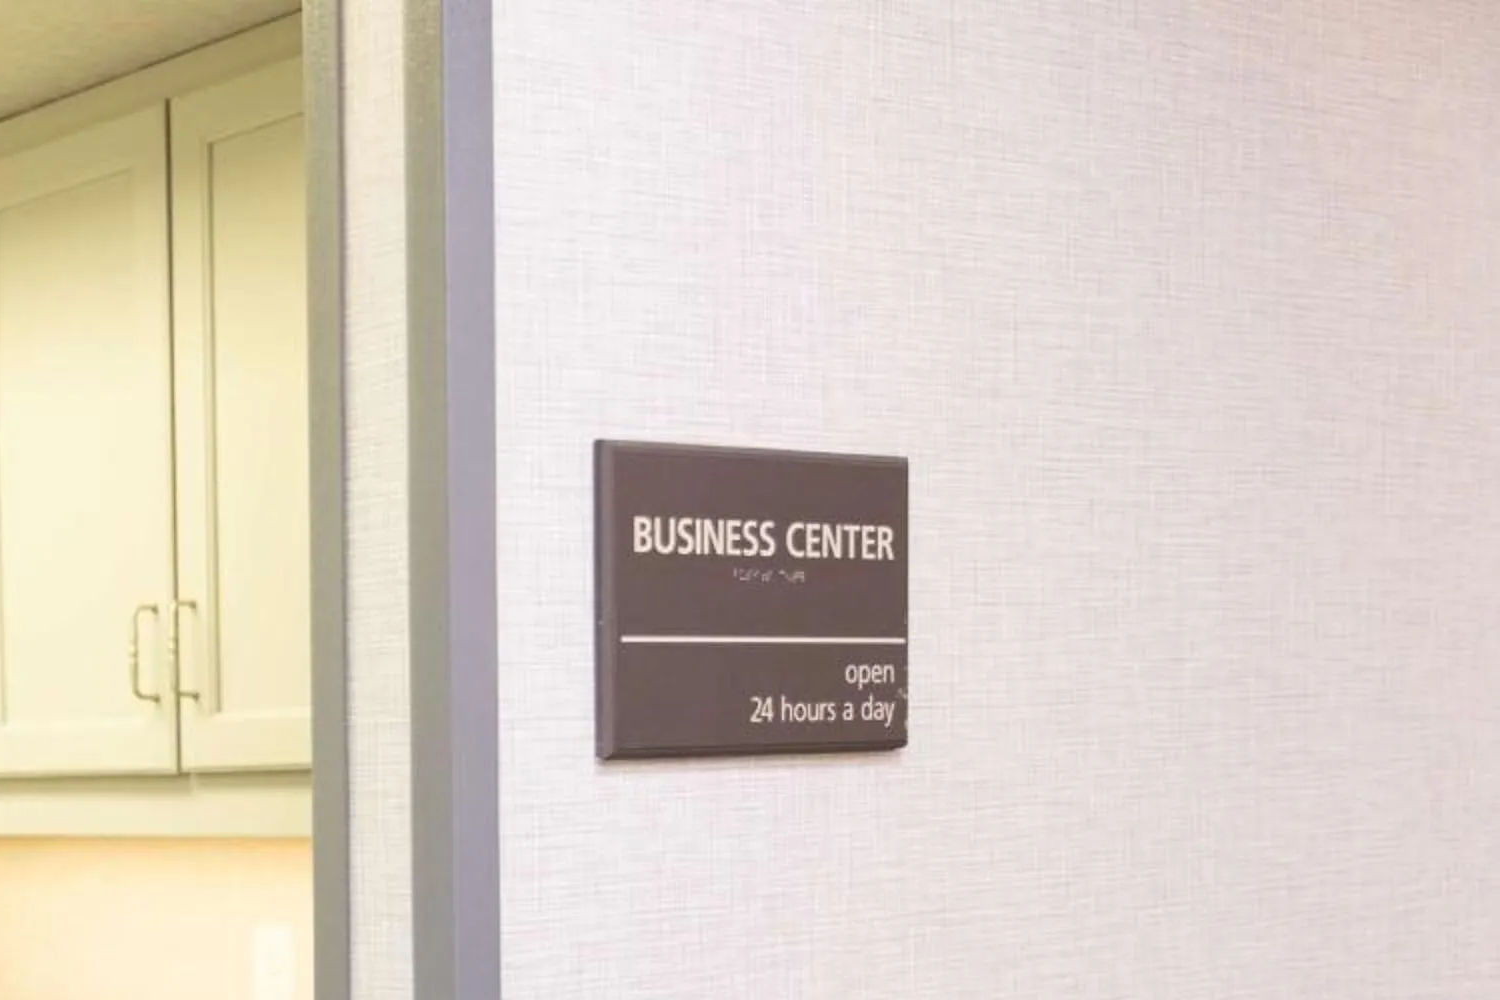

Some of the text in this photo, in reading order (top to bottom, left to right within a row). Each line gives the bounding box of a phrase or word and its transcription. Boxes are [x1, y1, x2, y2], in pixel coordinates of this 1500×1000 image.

[632, 515, 896, 561] BUSINESS CENTER
[844, 663, 896, 690] open
[749, 695, 896, 728] 24 hours a day
